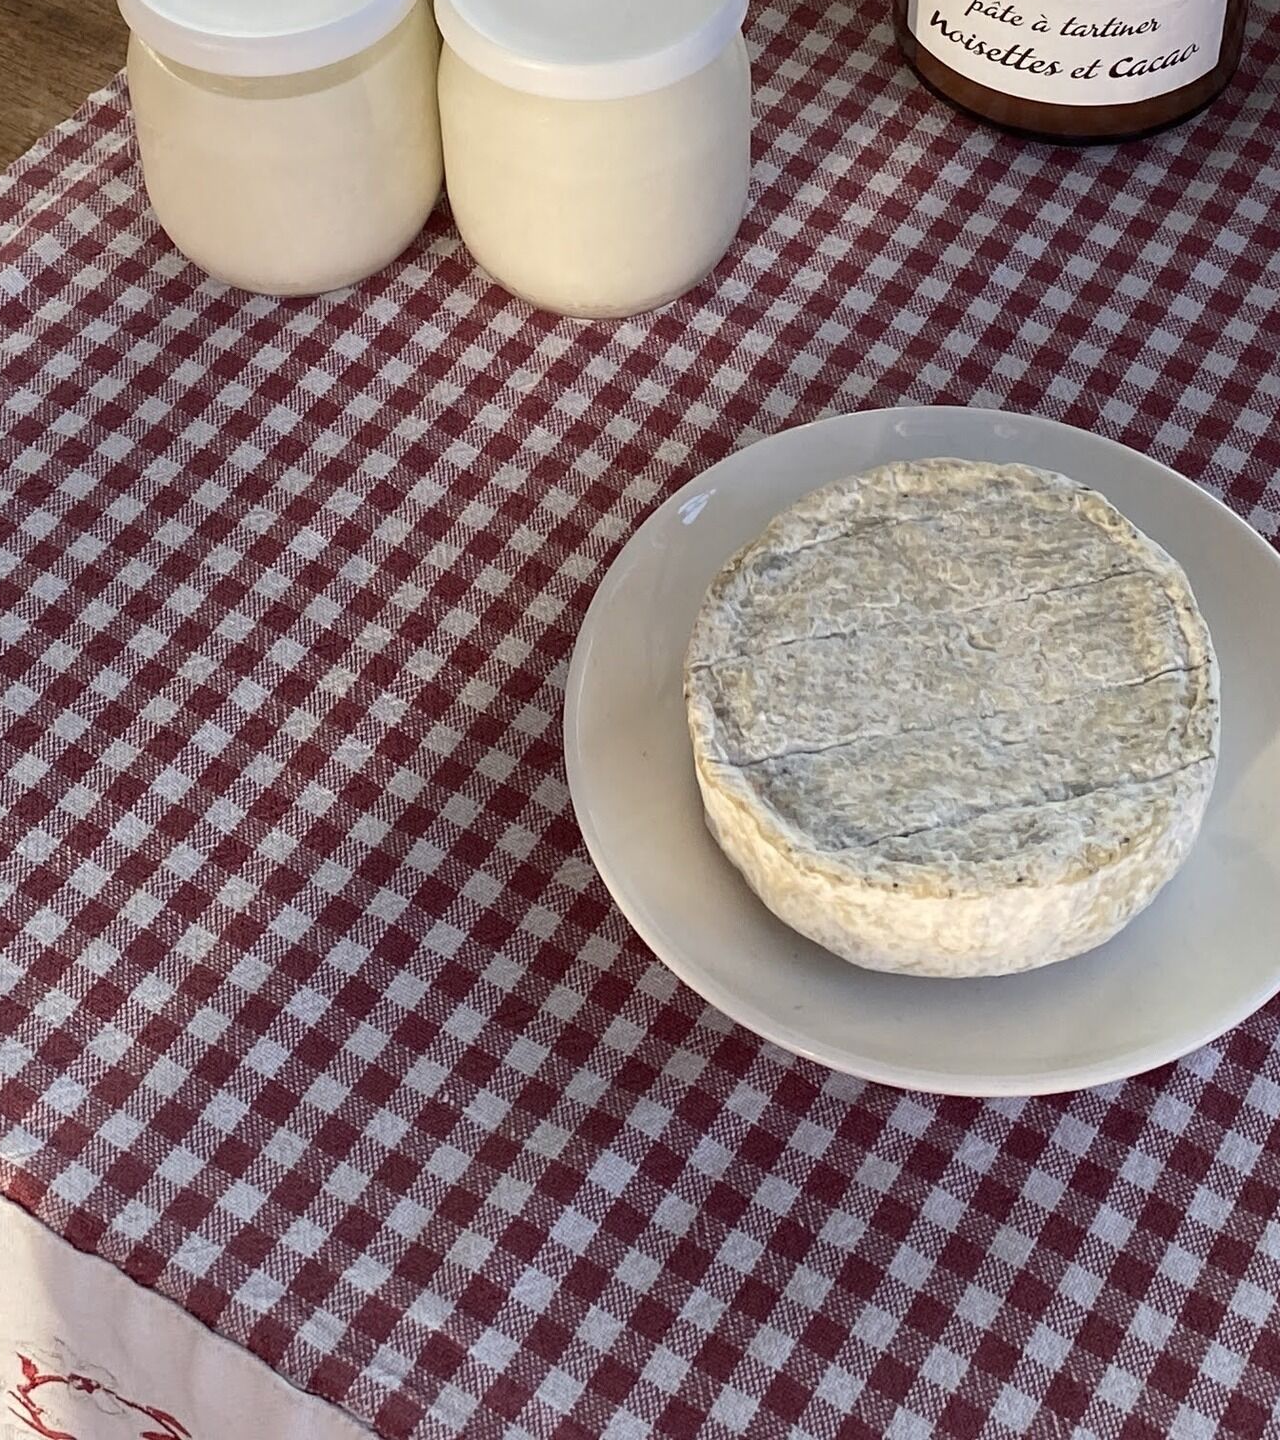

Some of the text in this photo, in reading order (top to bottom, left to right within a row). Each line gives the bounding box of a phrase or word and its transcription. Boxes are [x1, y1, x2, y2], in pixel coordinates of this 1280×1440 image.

[1031, 14, 1051, 33] à
[1060, 17, 1162, 38] tartiner
[1070, 60, 1105, 79] et
